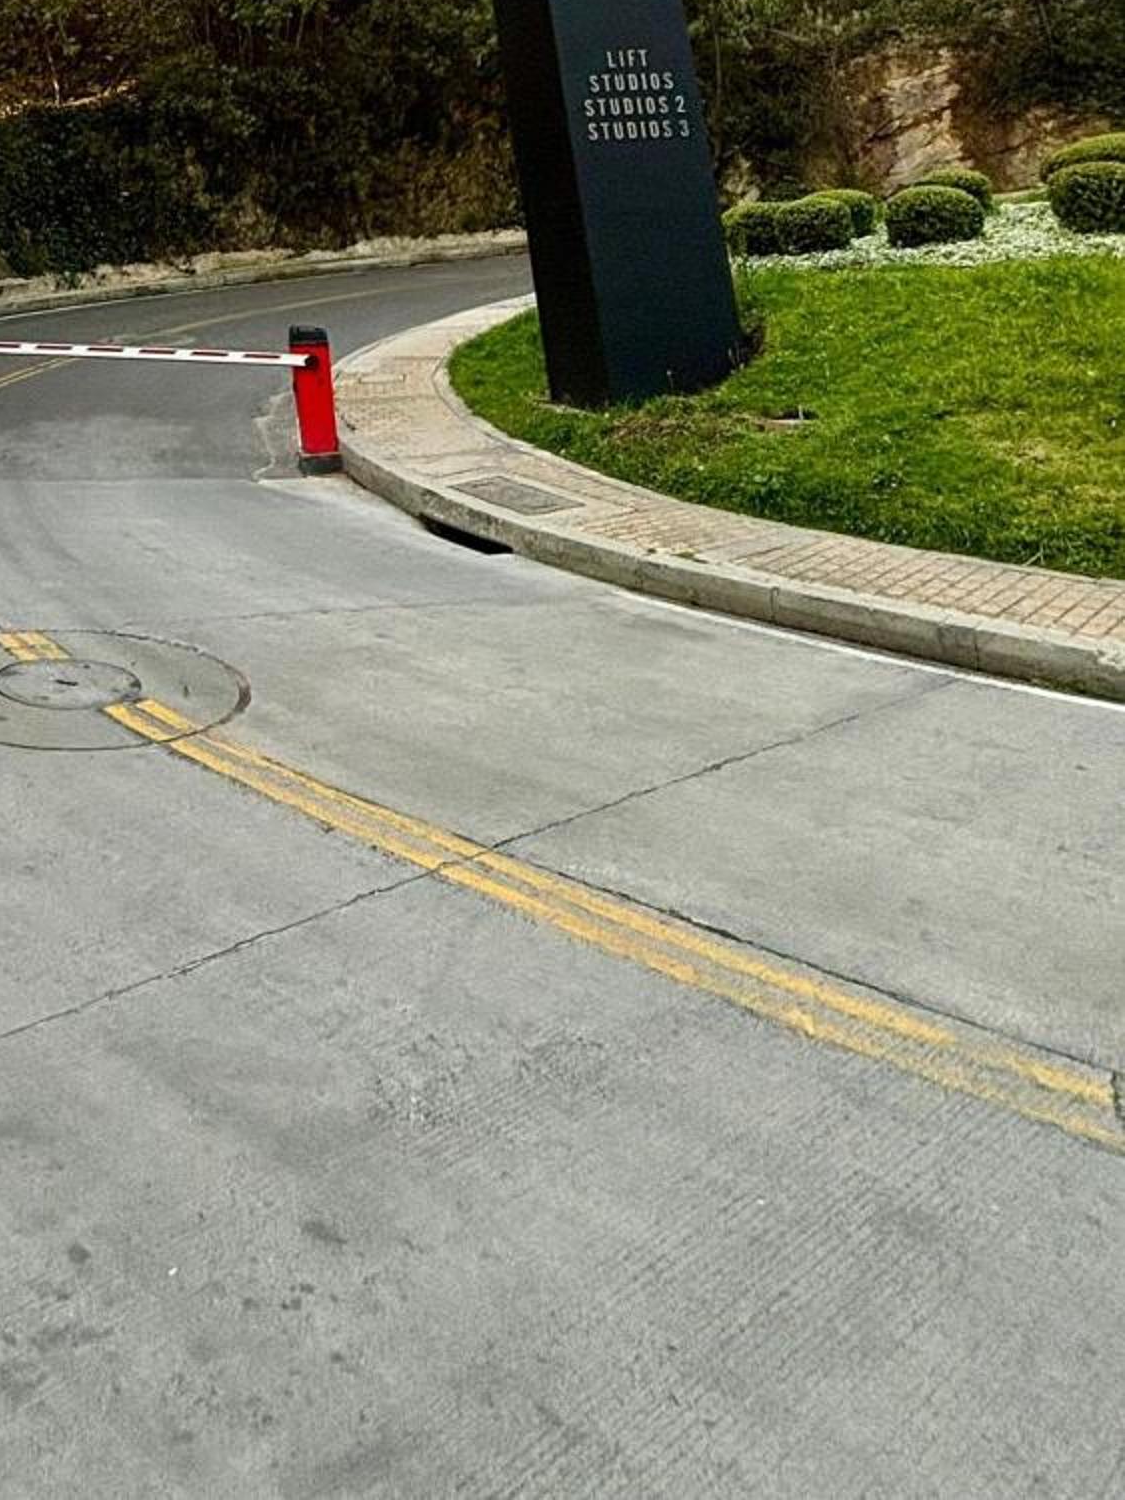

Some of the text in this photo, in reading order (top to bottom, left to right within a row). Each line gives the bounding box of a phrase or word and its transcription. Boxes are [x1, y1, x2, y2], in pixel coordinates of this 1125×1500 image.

[606, 49, 648, 68] LIFT
[588, 72, 674, 93] STUDIOS
[584, 95, 686, 117] STUDIOS 2
[587, 119, 690, 141] STUDIOS 3
